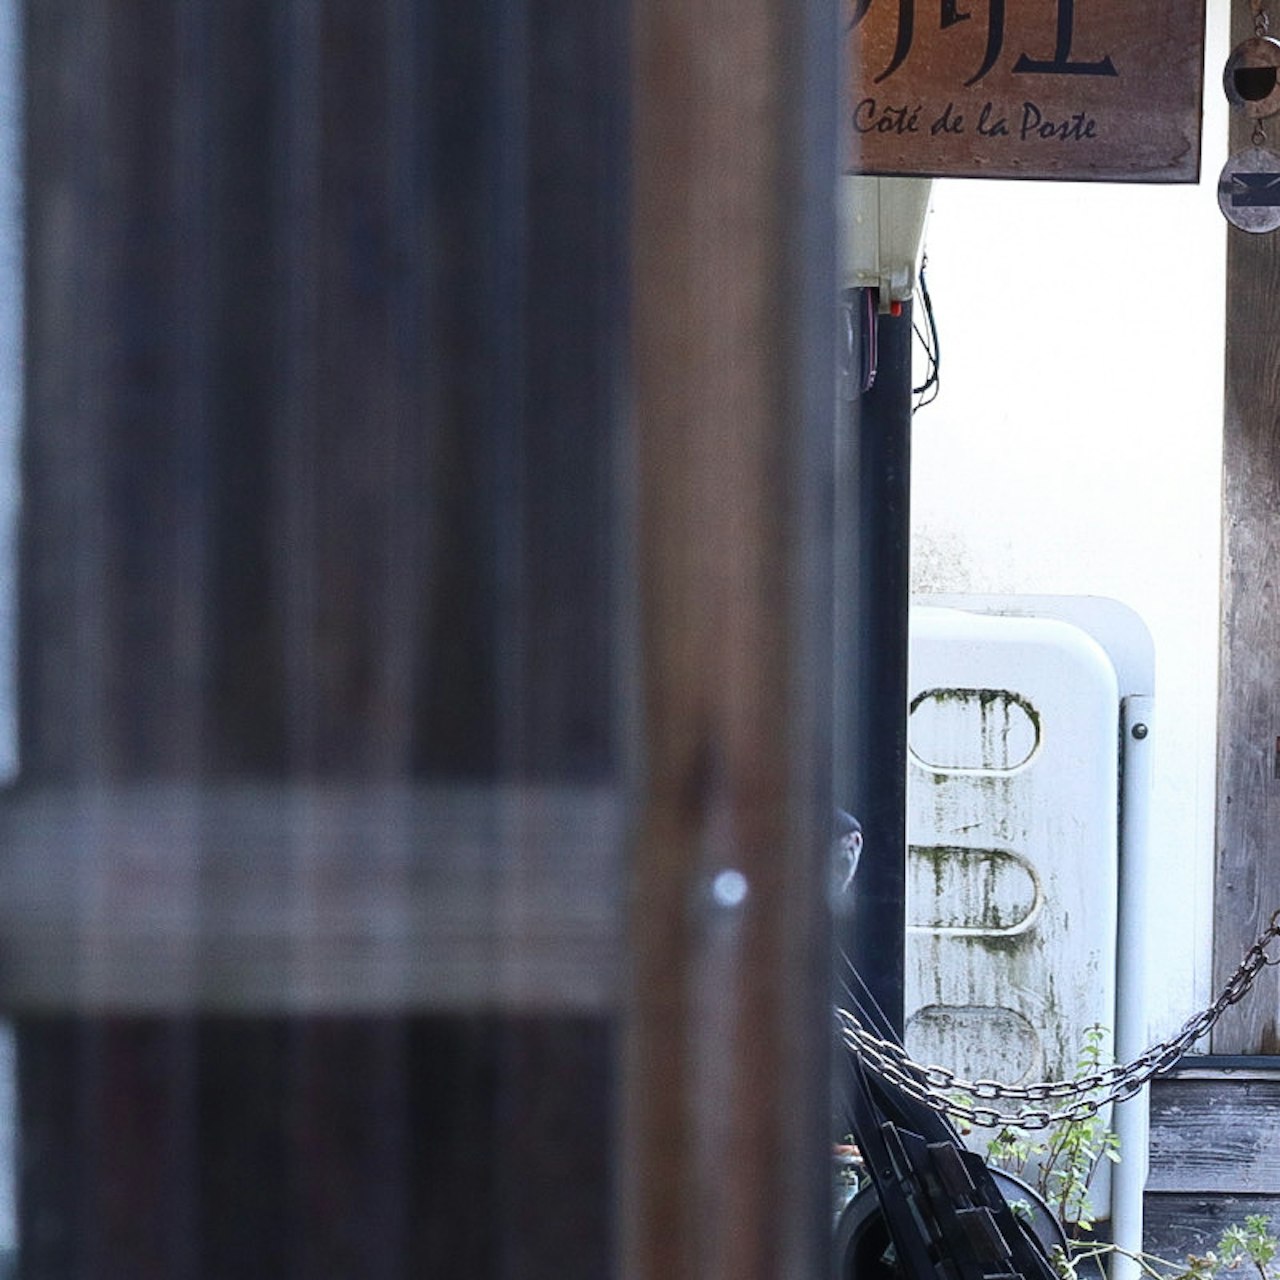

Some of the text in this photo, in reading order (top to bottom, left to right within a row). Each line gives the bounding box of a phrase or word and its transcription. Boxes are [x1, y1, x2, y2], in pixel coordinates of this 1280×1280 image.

[931, 102, 964, 136] de
[976, 102, 1010, 137] la
[1020, 102, 1099, 142] Poste
